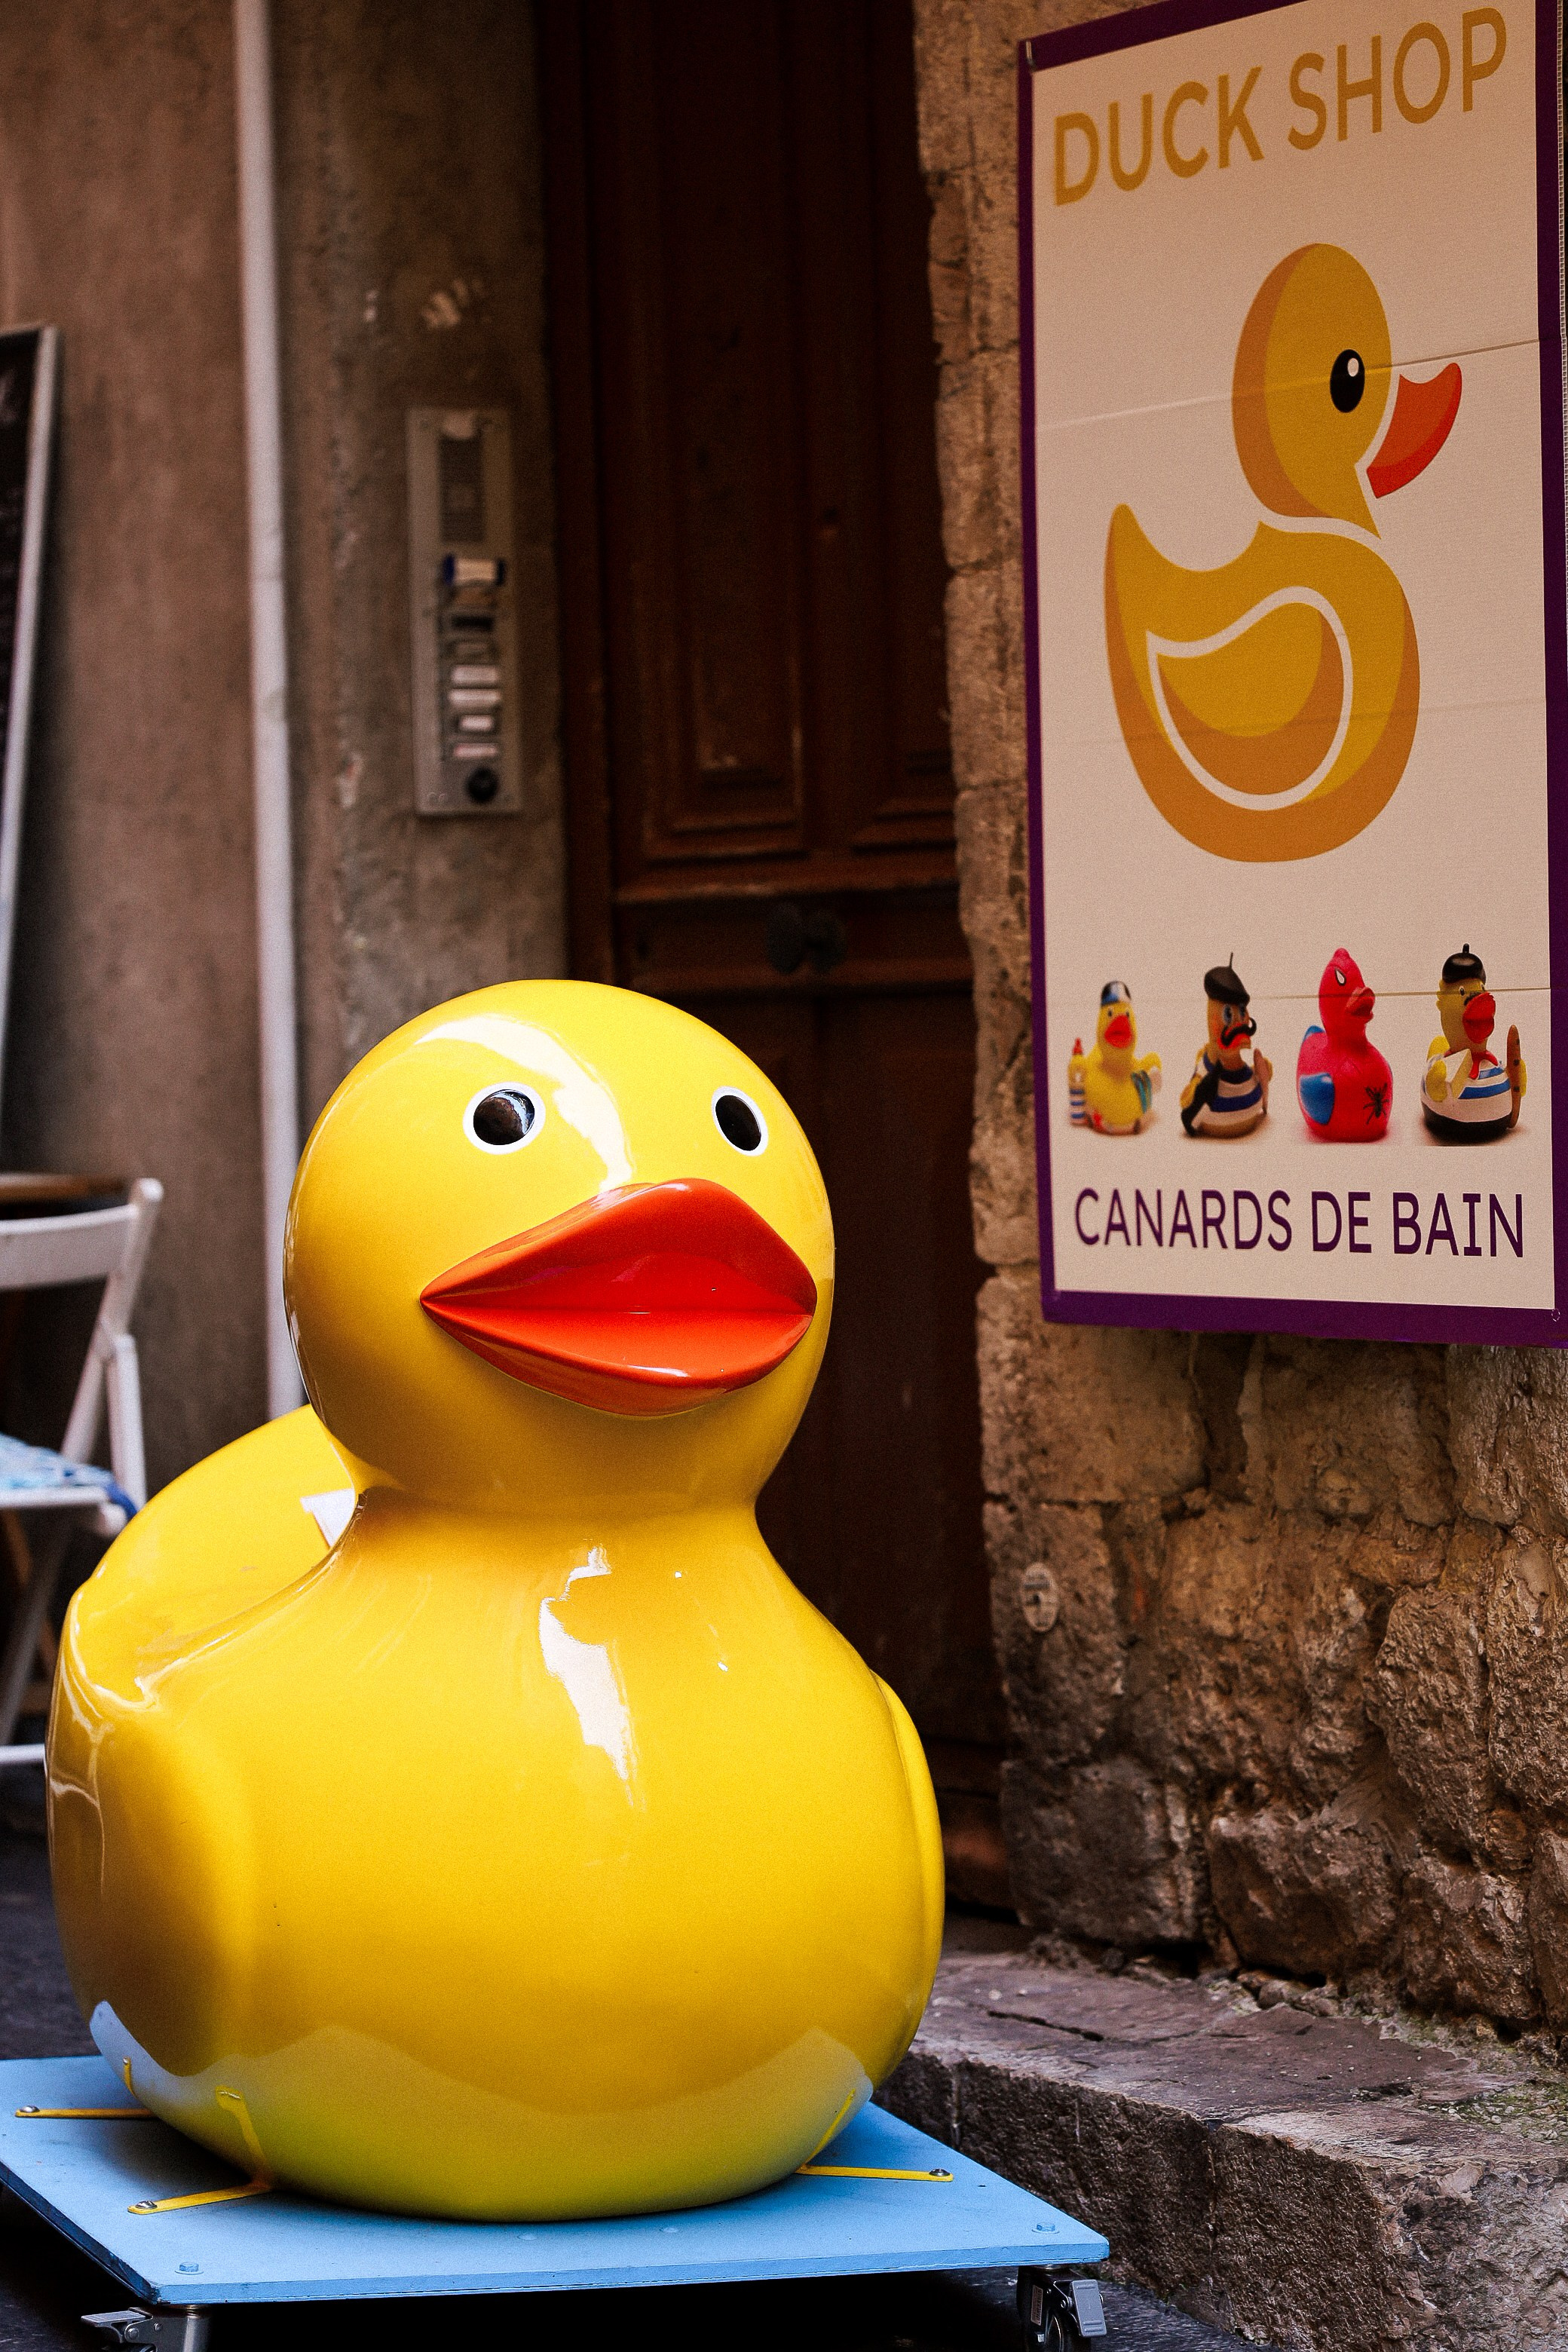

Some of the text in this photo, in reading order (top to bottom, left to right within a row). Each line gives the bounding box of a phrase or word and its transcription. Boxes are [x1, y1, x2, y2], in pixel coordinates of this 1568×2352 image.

[1055, 6, 1507, 207] DUCK SHOP
[1075, 1187, 1524, 1258] CANARDS DE BAIN
